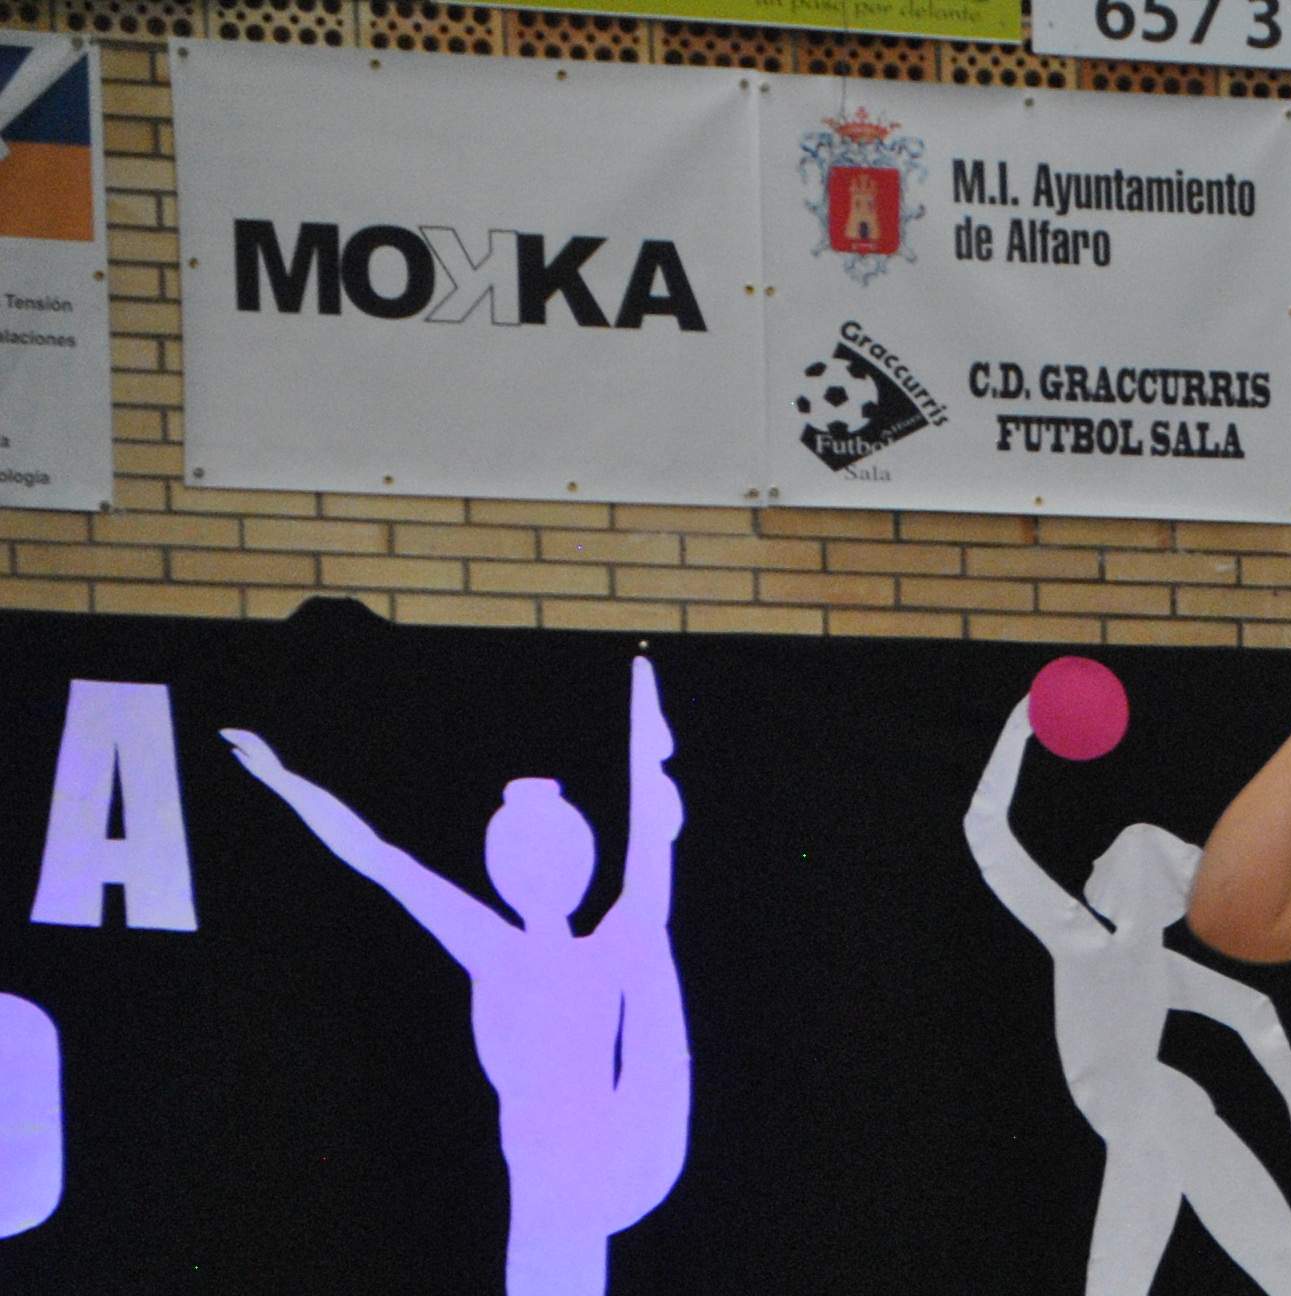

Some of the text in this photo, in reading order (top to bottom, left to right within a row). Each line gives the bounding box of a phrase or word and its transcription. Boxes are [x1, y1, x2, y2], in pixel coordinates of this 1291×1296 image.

[952, 158, 1257, 218] M.I. Ayuntamiento
[954, 216, 1112, 267] de Alfaro
[4, 292, 74, 314] Tensión
[839, 320, 949, 428] Graccurris
[968, 360, 1272, 409] C.D. GRACCURRIS
[996, 413, 1246, 460] FUTBOL SALA
[843, 463, 892, 483] Sala
[29, 677, 199, 932] A
